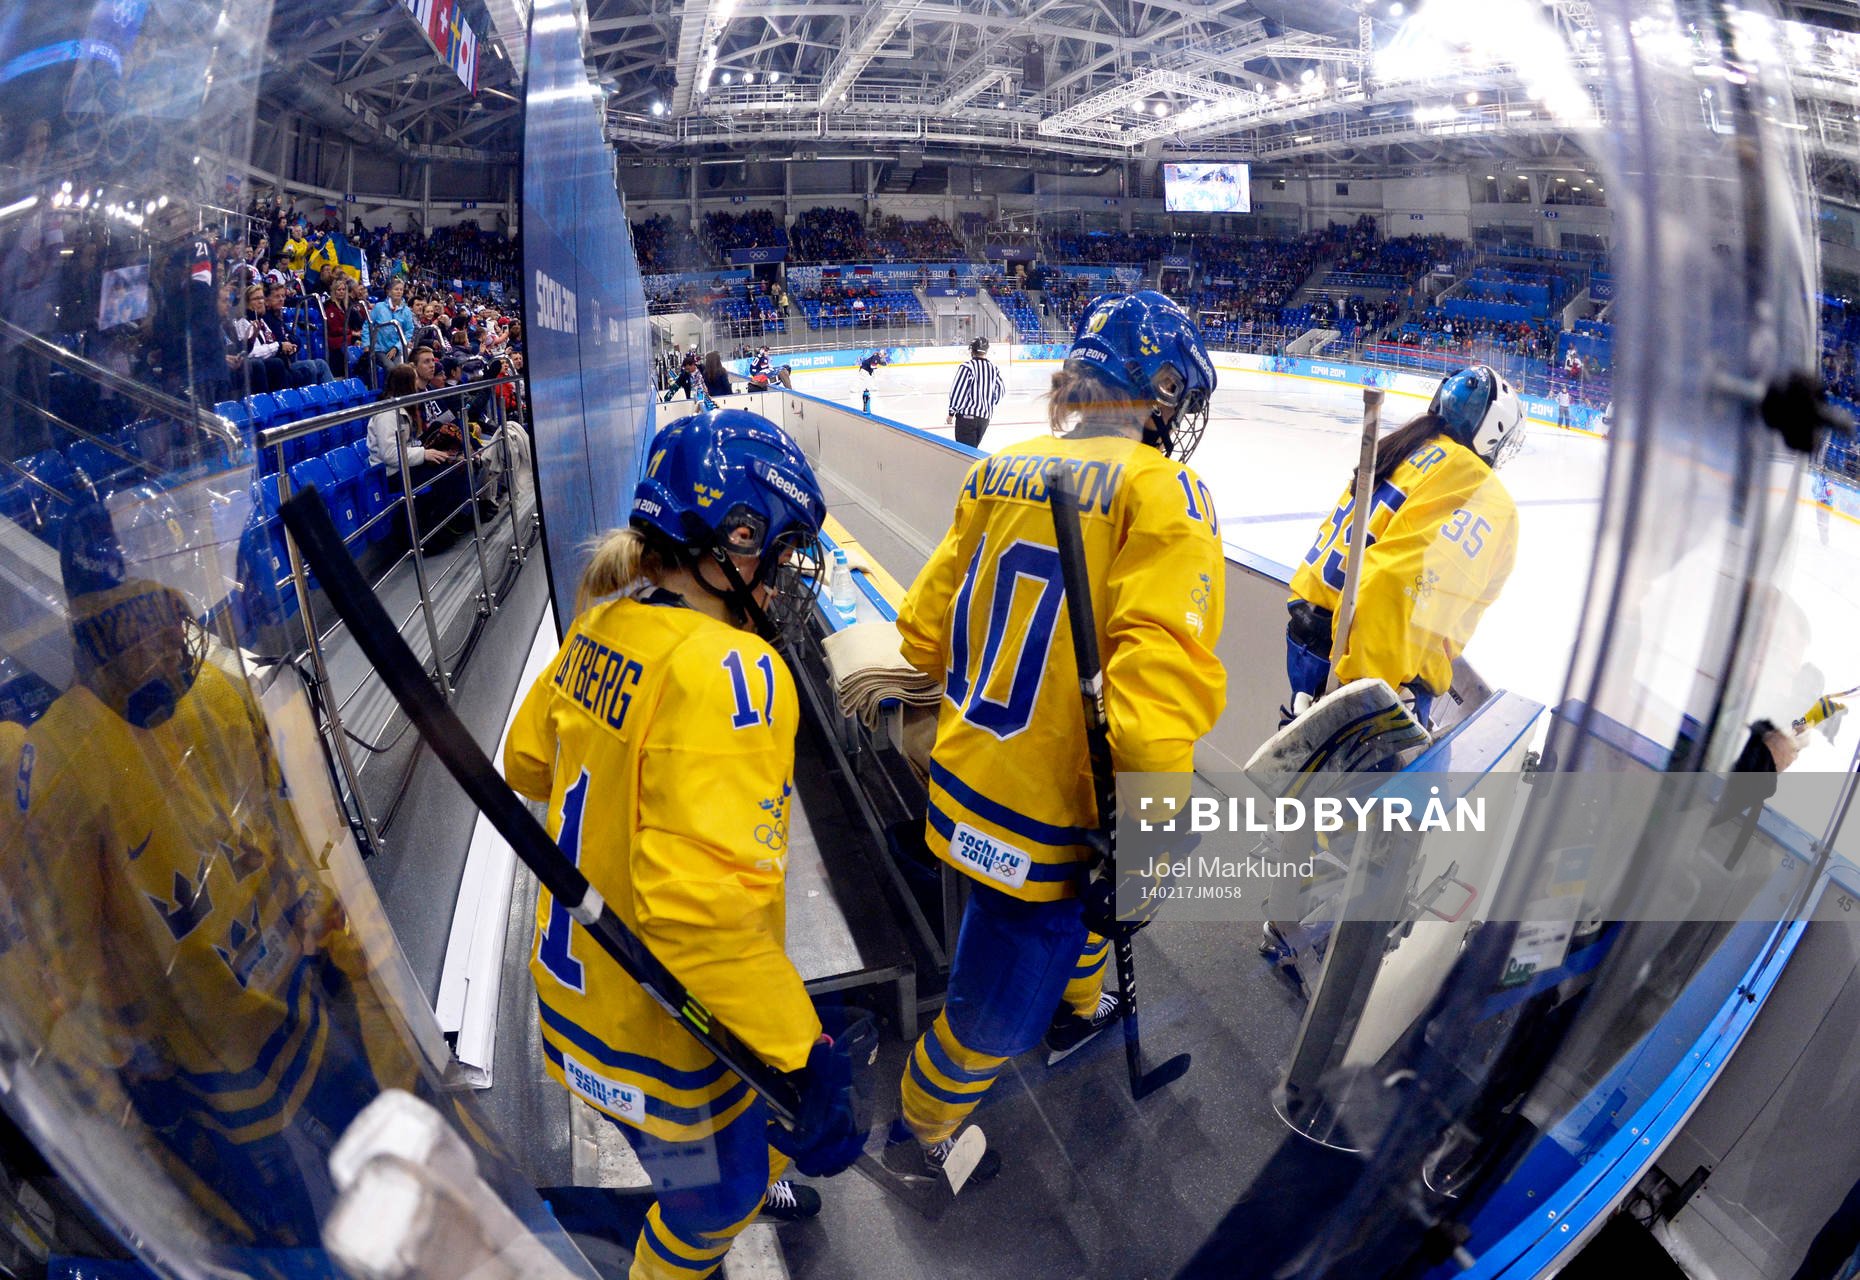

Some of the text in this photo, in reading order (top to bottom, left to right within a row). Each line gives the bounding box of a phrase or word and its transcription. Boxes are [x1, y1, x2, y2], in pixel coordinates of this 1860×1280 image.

[888, 270, 919, 279] ЗИМНИ
[813, 355, 834, 365] 2014
[1085, 349, 1108, 363] 2014
[1329, 367, 1346, 379] 2014
[1530, 402, 1554, 418] 2014
[1408, 446, 1447, 474] ER
[766, 467, 811, 509] Reebok
[640, 499, 662, 518] 2014
[1176, 469, 1218, 537] 10
[1440, 508, 1493, 561] 35
[944, 532, 1067, 742] 10
[719, 648, 775, 731] 11
[957, 830, 1021, 868] sochi.ru
[961, 845, 994, 873] 2014
[1836, 895, 1854, 913] 45
[567, 1061, 633, 1103] sochi.ru
[575, 1076, 608, 1106] 2014
